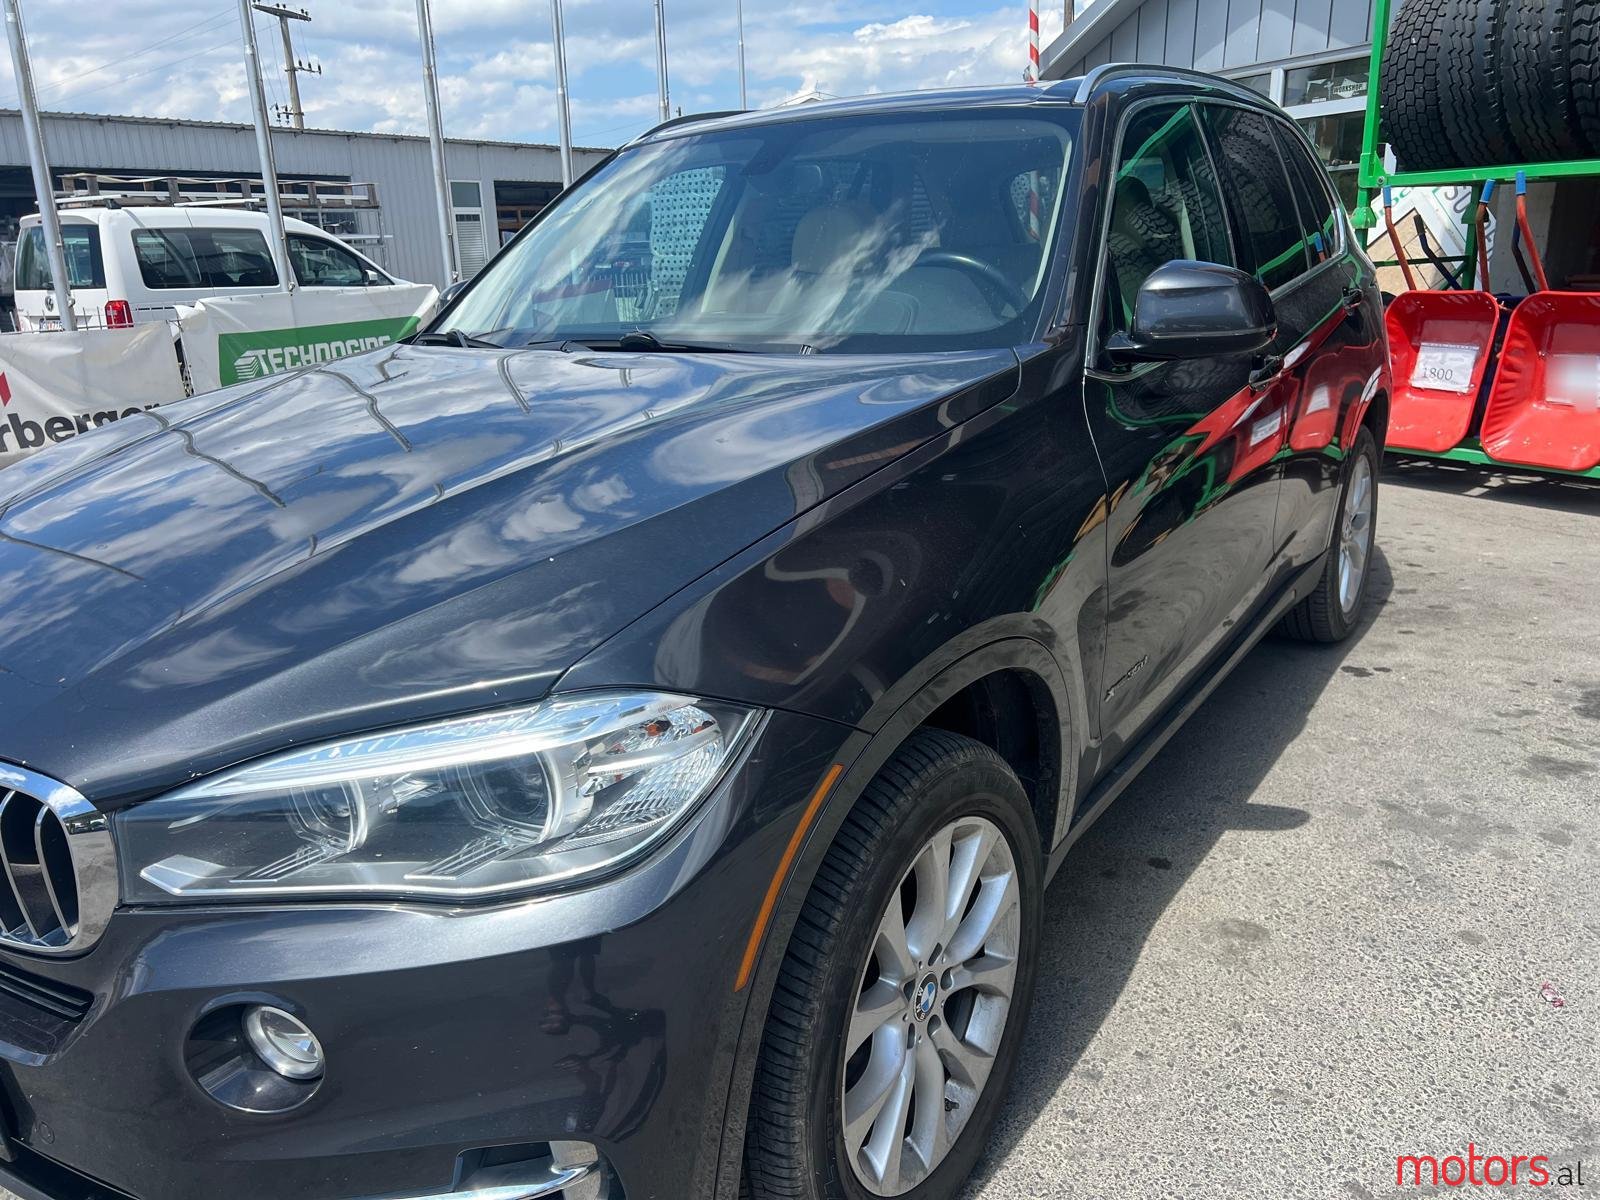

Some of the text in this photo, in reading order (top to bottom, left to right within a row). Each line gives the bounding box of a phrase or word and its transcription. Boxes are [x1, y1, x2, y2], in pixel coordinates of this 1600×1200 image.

[1333, 84, 1363, 94] WORKSHOP
[1422, 367, 1453, 381] 1800
[0, 403, 160, 453] rber
